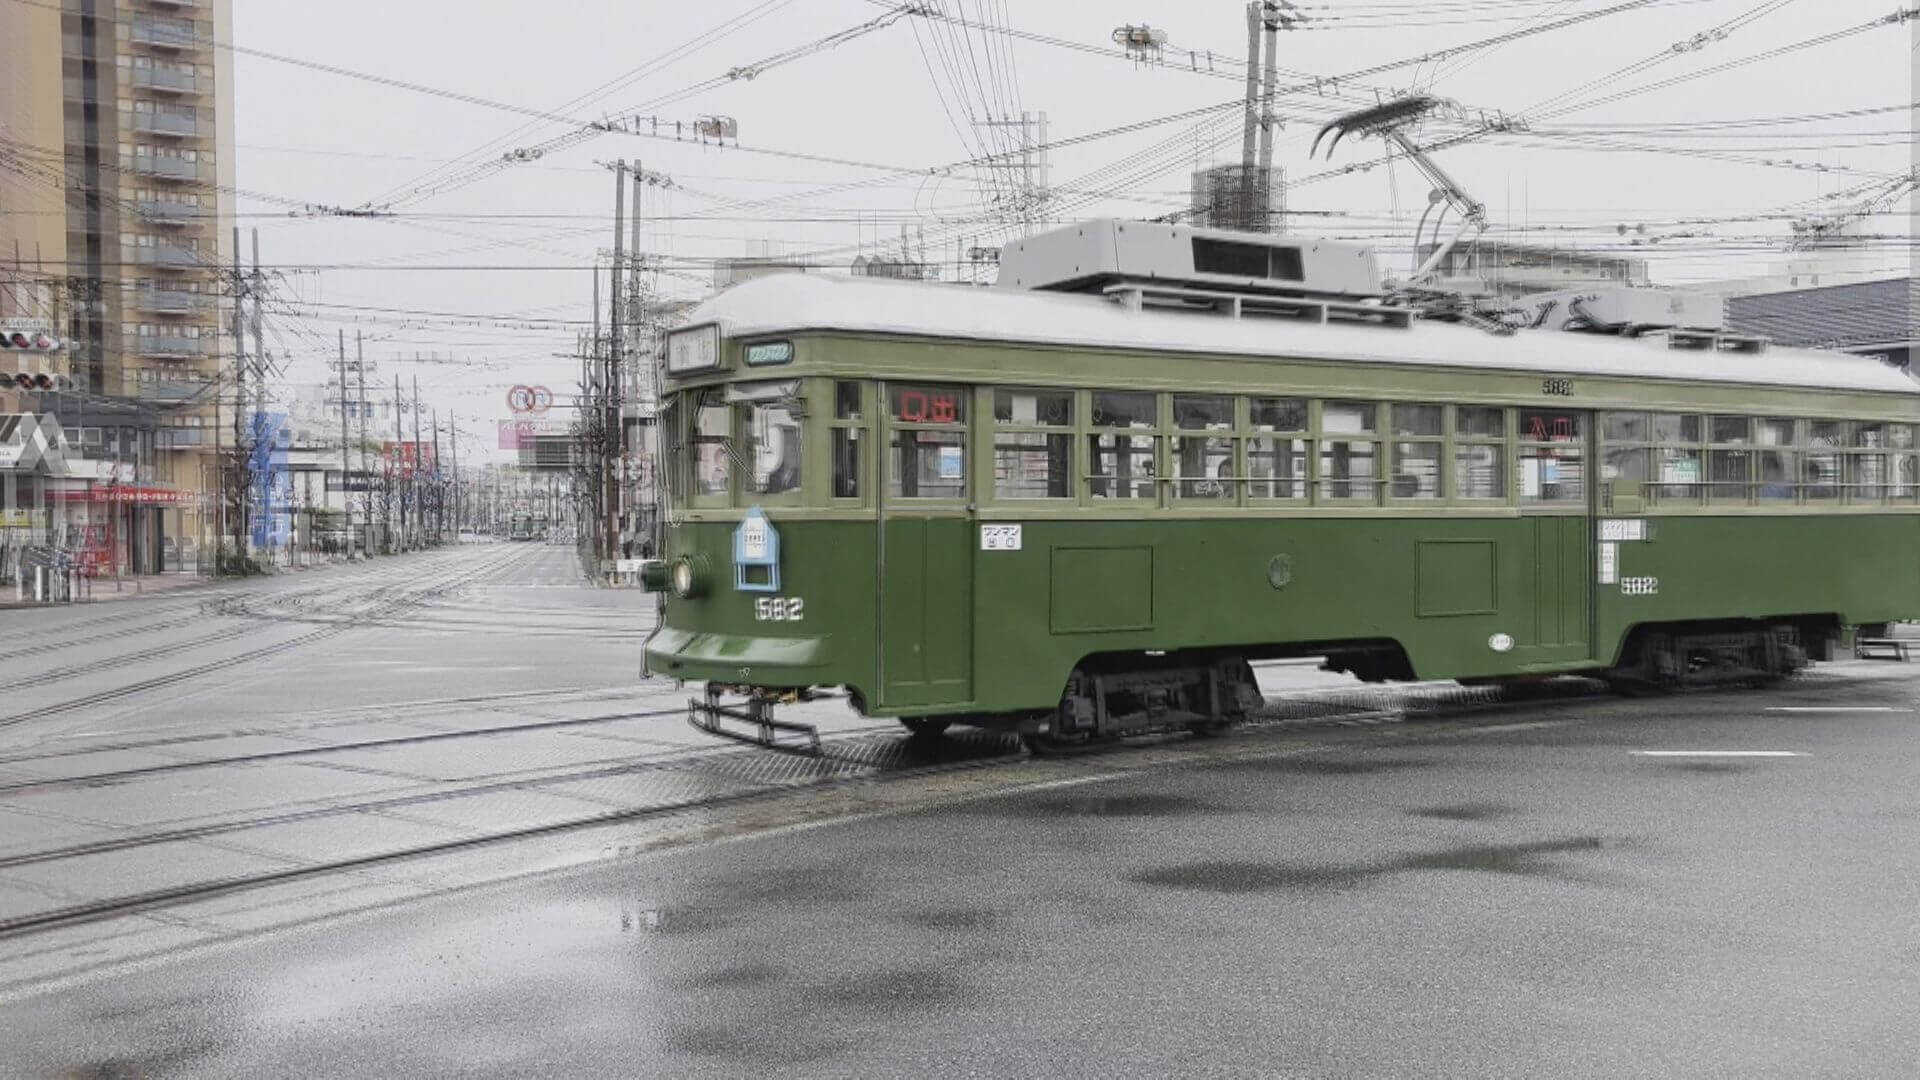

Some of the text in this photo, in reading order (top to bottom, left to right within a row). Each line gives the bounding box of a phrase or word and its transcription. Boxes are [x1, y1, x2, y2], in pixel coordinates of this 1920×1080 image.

[1542, 378, 1574, 396] 582
[1620, 577, 1659, 594] 582
[755, 597, 804, 620] 582
